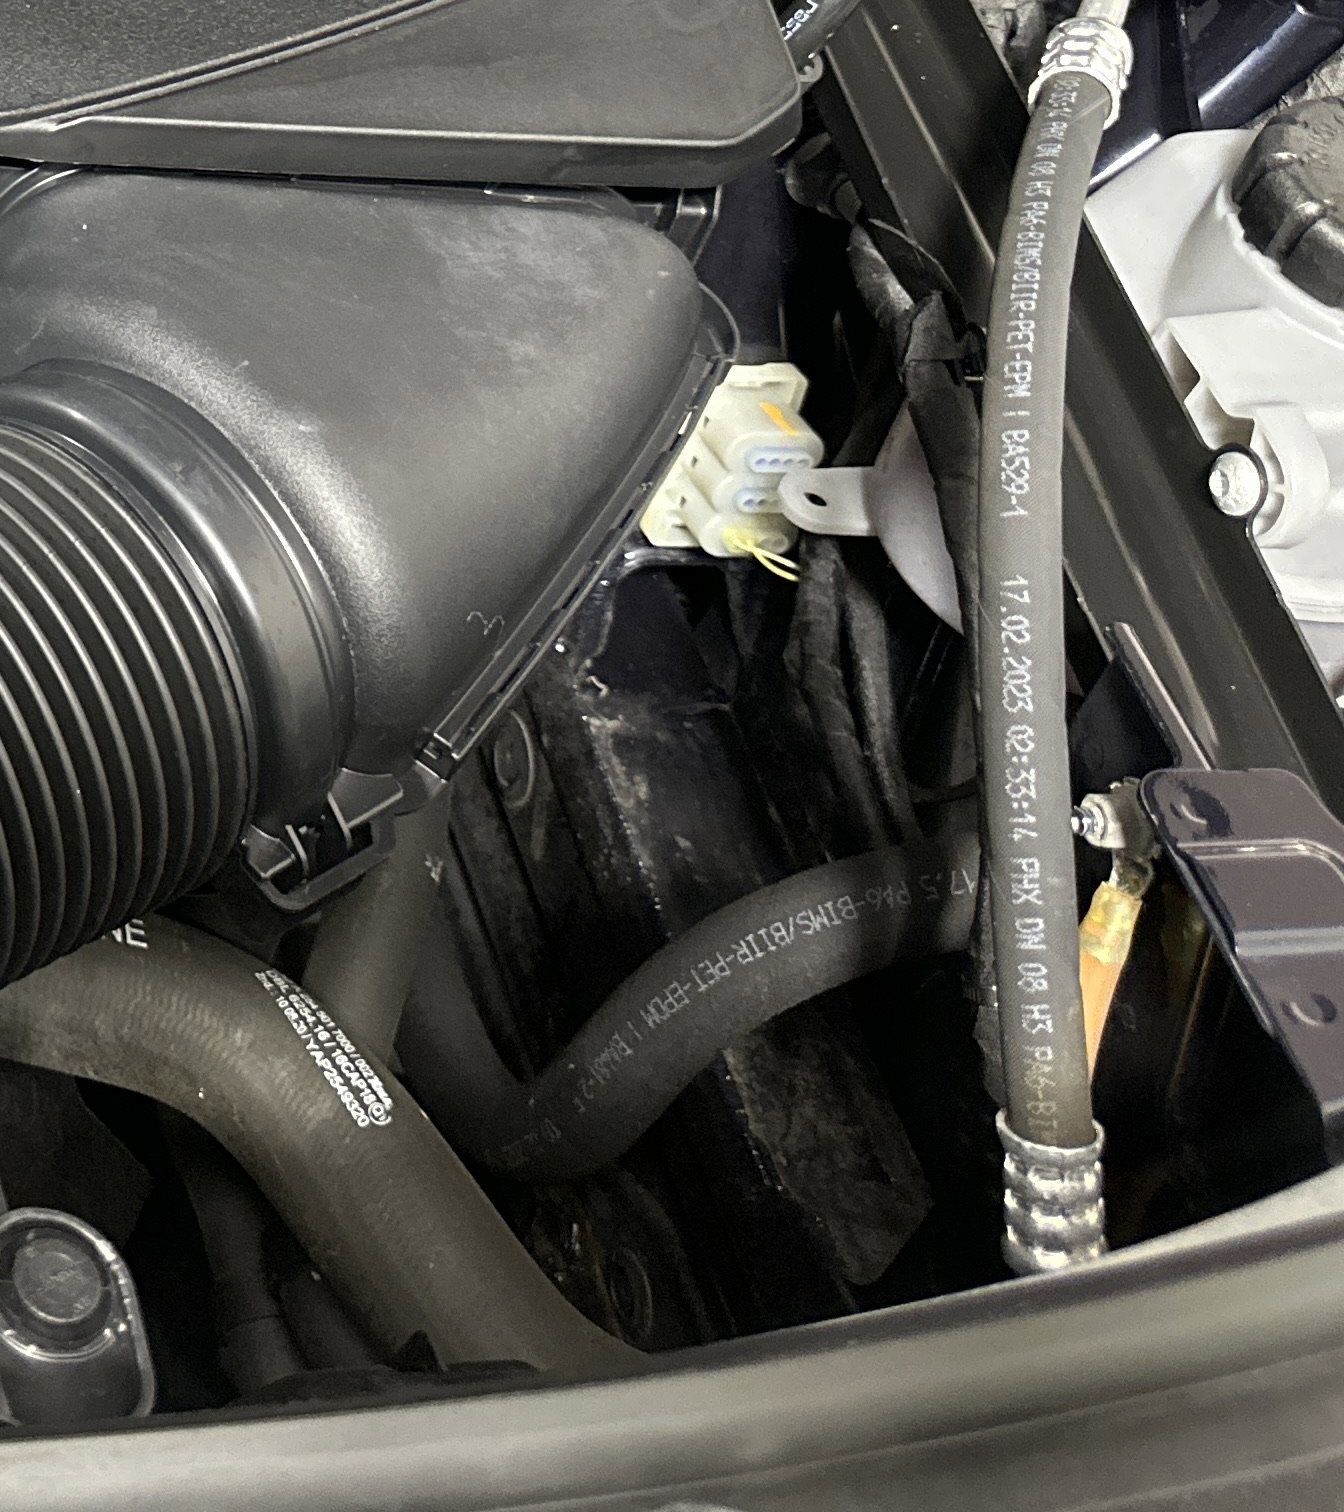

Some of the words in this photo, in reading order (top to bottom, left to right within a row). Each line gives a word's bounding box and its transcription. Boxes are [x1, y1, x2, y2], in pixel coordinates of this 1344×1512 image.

[1000, 574, 1032, 713] 17.02.2023
[1006, 724, 1039, 840] 02:33:14
[1013, 917, 1047, 950] DN
[1015, 962, 1050, 992] 08
[1020, 1004, 1054, 1034] H3
